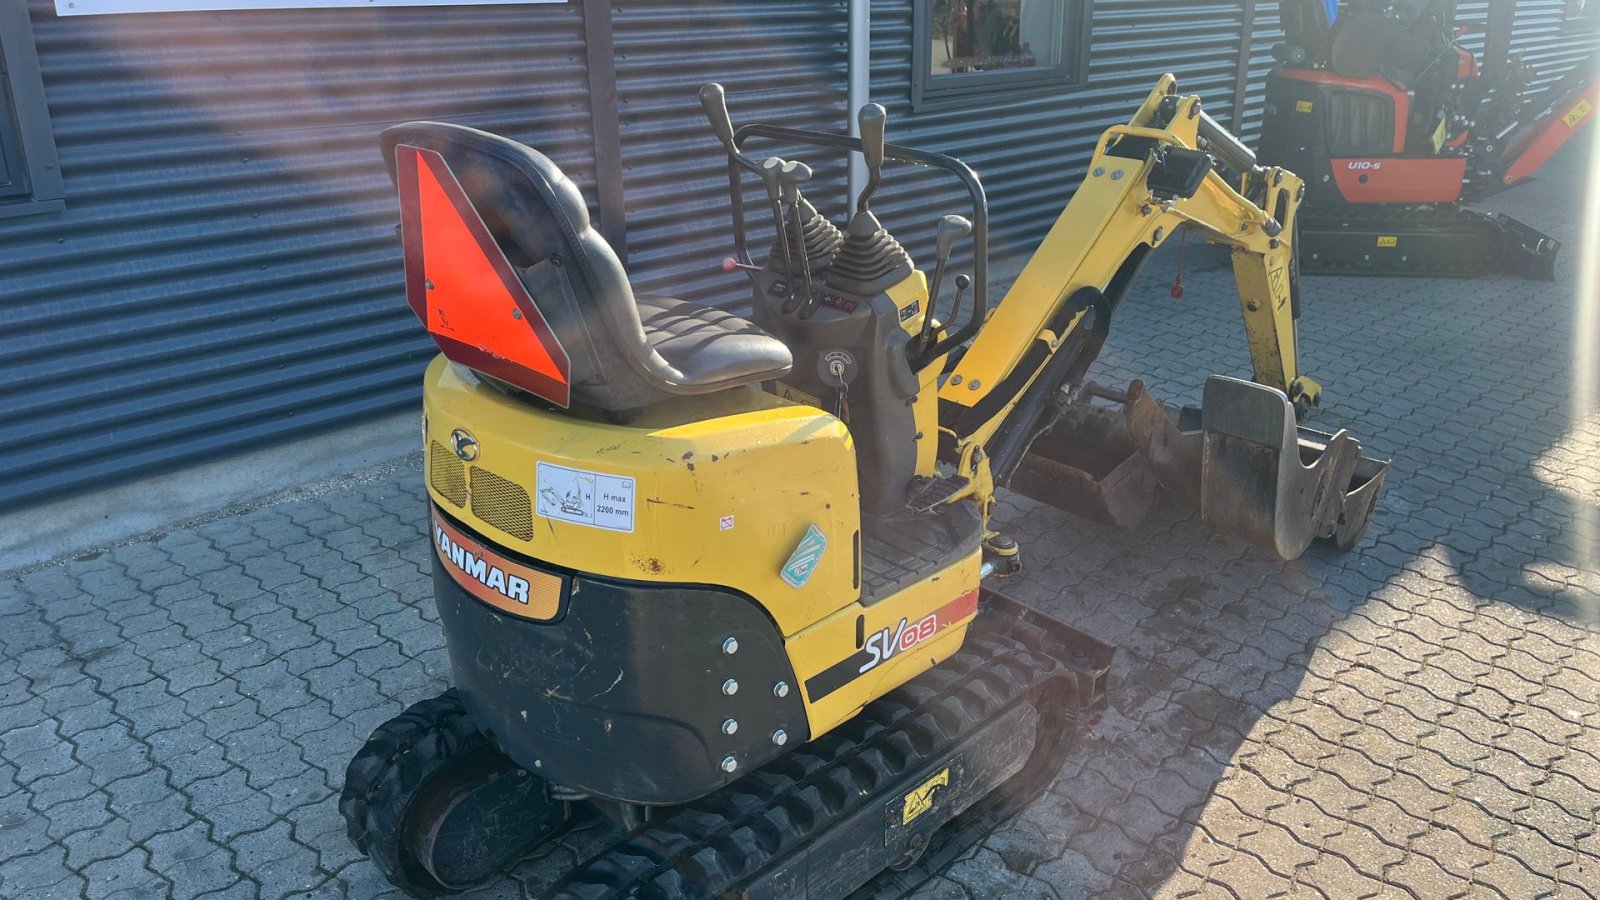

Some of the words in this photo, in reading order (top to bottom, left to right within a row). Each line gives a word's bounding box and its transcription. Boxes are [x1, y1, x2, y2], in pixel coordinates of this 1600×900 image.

[585, 493, 591, 501] H
[603, 492, 609, 500] H
[596, 505, 614, 514] 2200
[615, 508, 629, 516] mm
[434, 520, 530, 605] YANMAR
[859, 614, 937, 674] SV08
